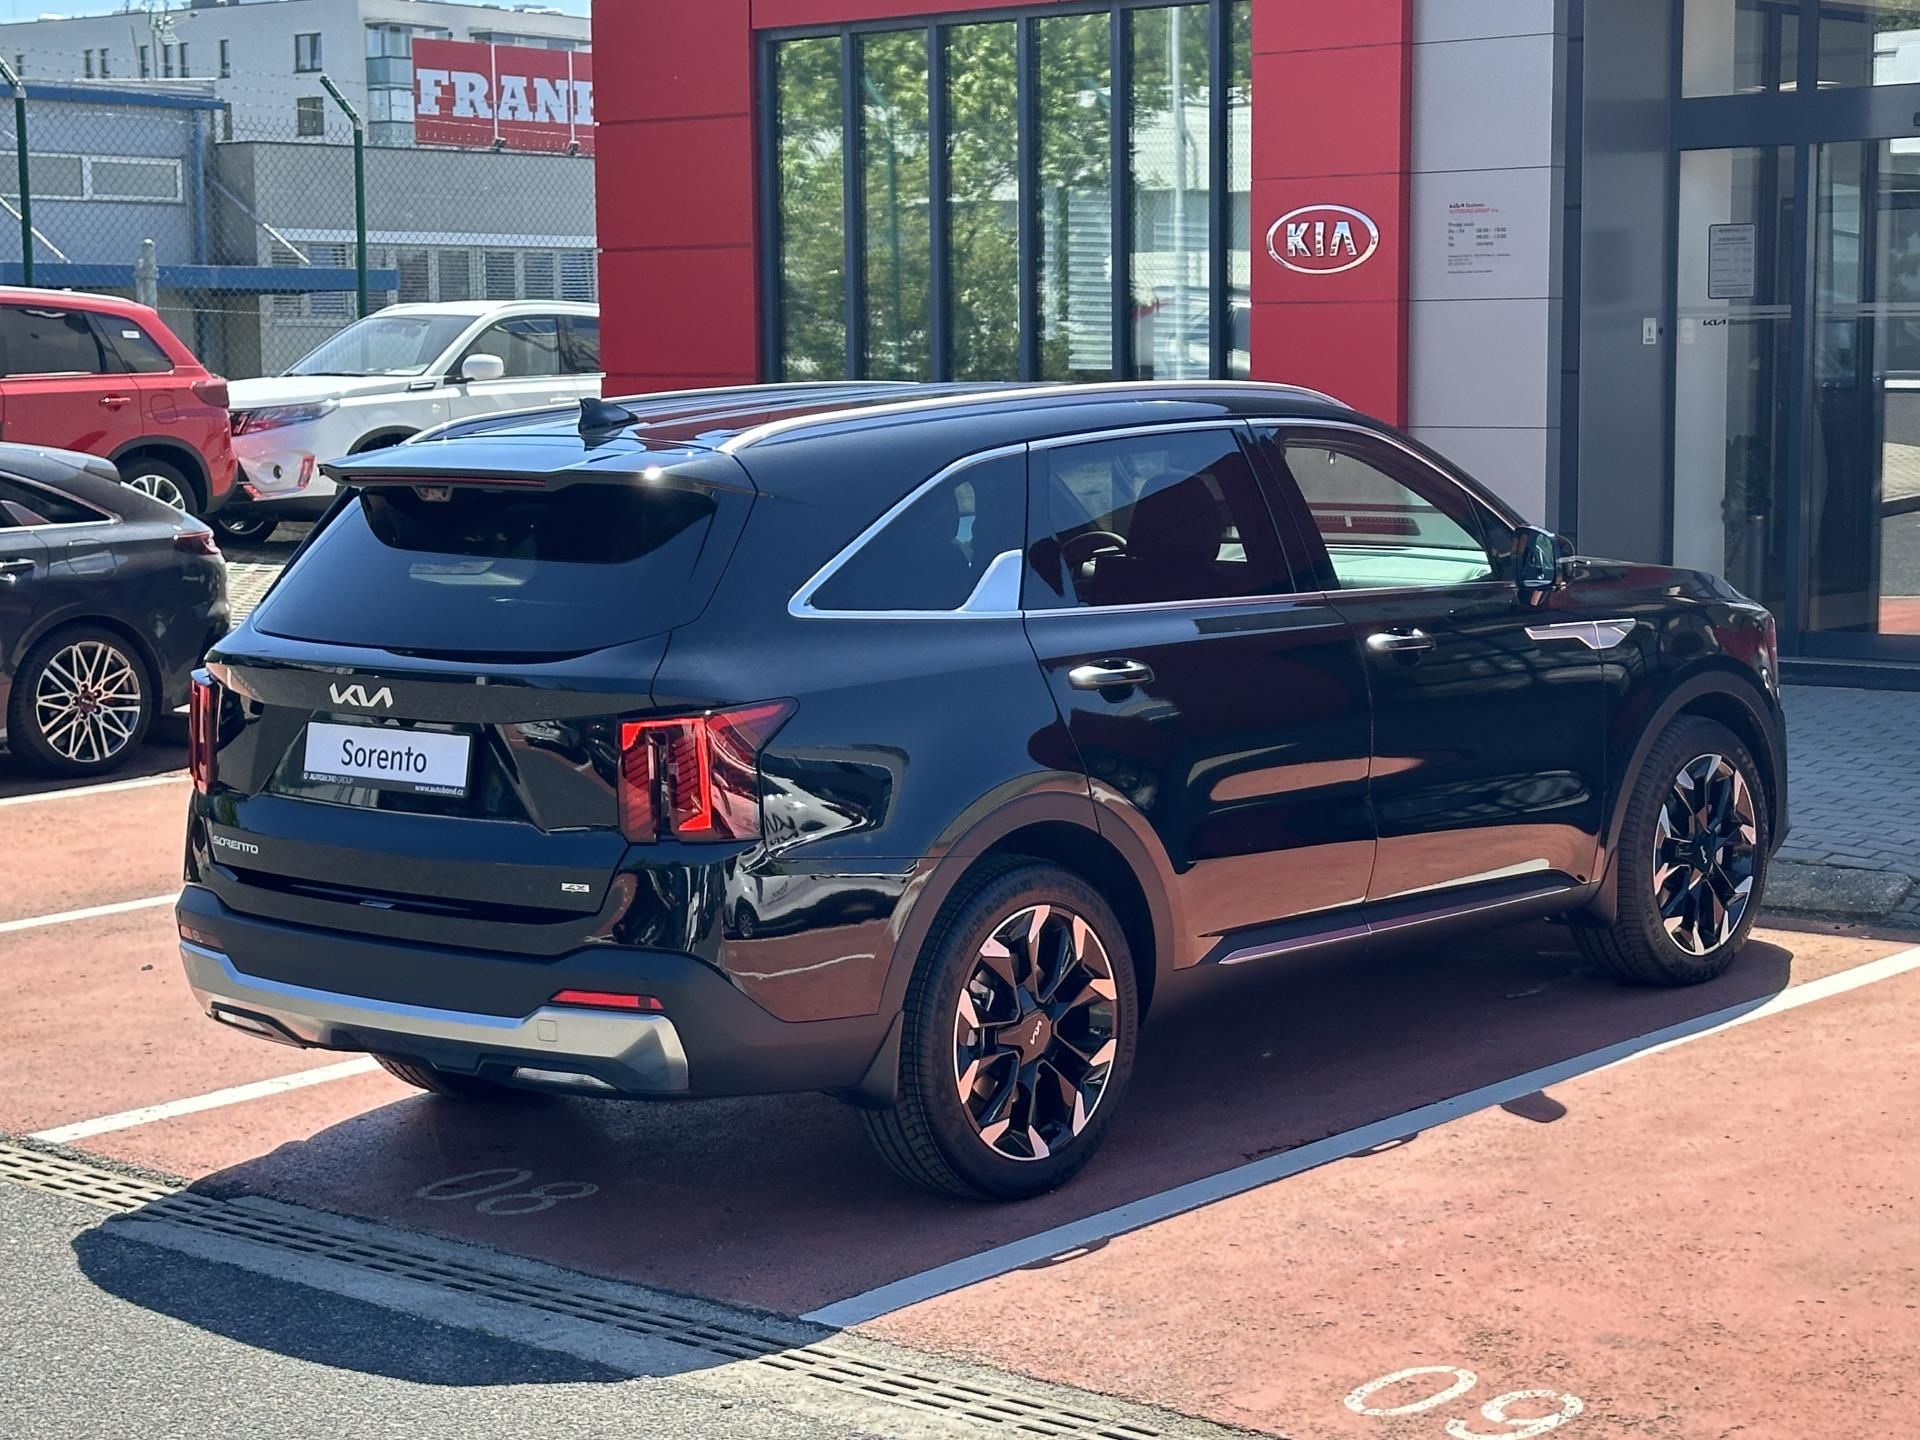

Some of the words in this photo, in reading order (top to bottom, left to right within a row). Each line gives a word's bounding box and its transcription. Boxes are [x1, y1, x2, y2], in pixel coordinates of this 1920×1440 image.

[1286, 221, 1358, 257] KIA
[328, 682, 394, 708] KIA
[341, 738, 427, 773] Sorento
[212, 835, 259, 855] SORENTO
[413, 1167, 600, 1216] 08
[1343, 1364, 1584, 1440] 09
